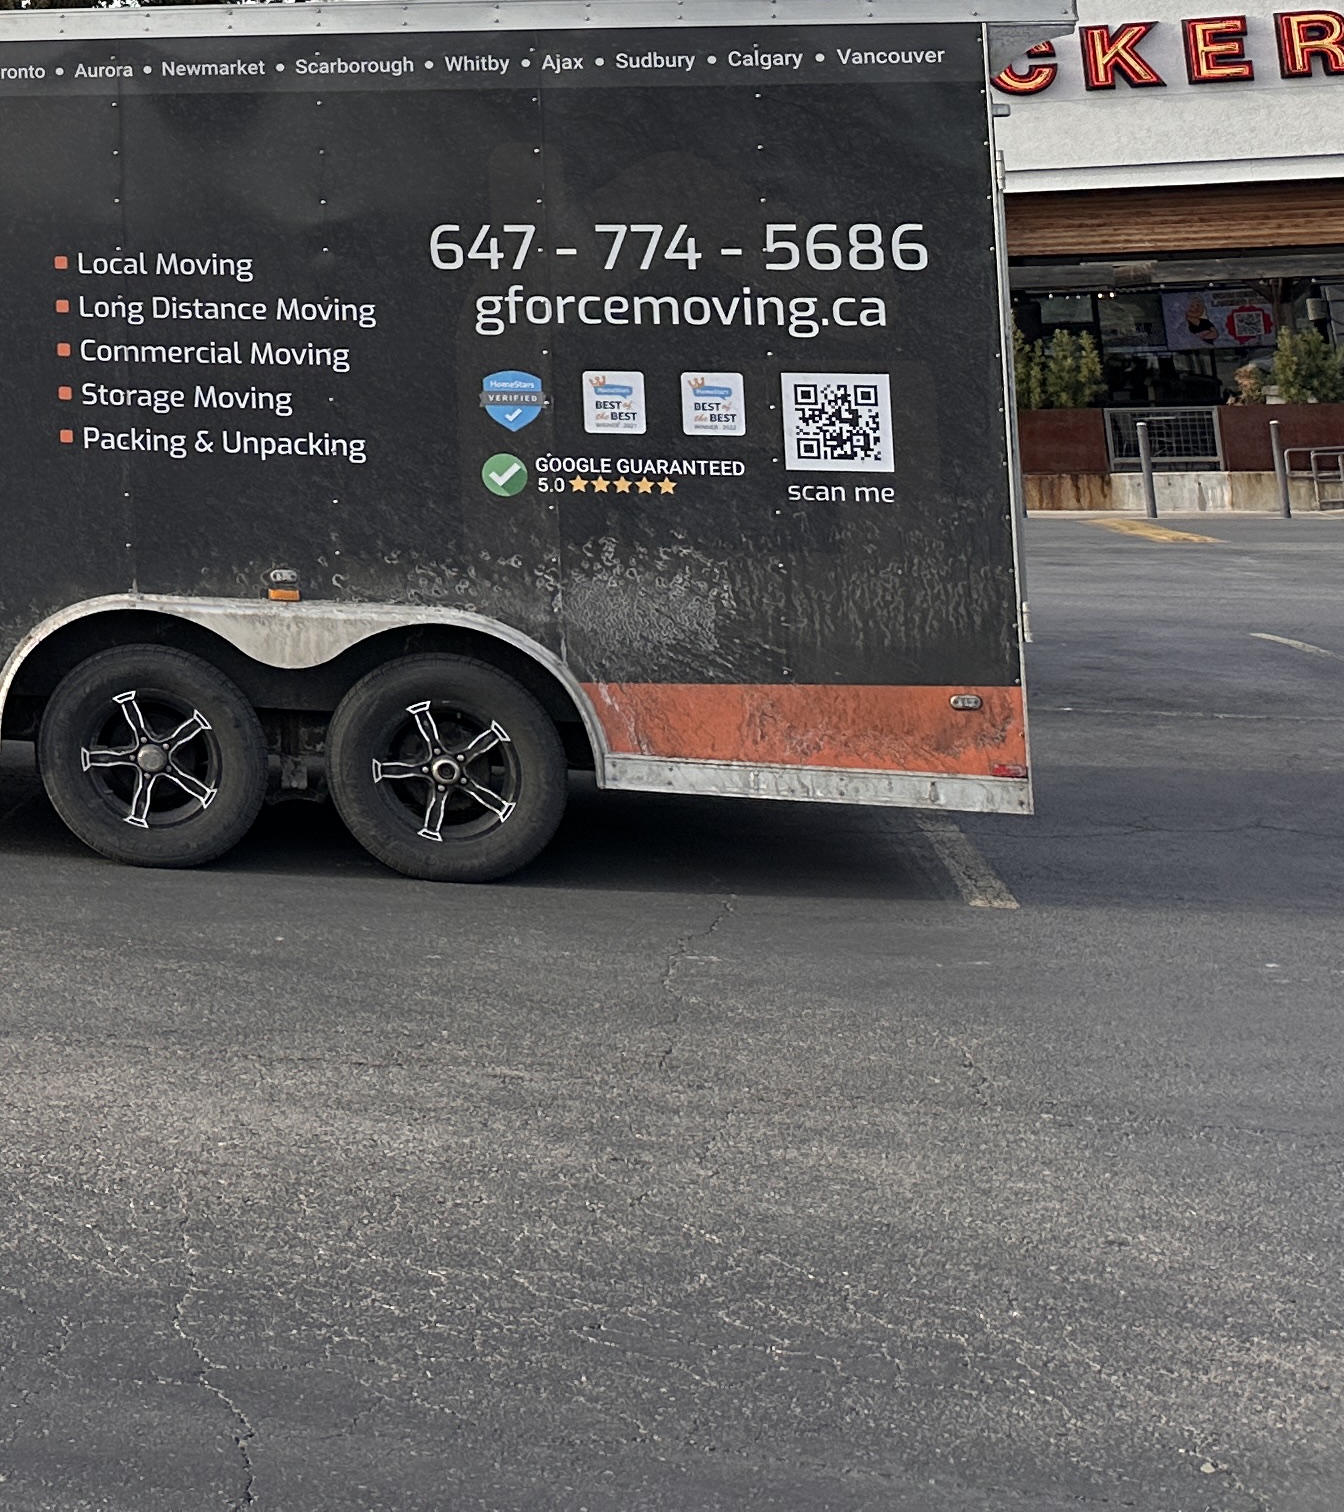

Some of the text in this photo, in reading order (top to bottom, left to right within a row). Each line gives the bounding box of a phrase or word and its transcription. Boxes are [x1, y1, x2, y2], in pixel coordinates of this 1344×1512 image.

[74, 63, 134, 79] Aurora
[161, 59, 266, 77] Newmarket
[295, 56, 414, 77] Scarborough
[444, 55, 510, 75] Whitby
[541, 54, 584, 74] Ajax
[615, 51, 696, 72] Sudbury
[727, 49, 804, 71] Calgary
[836, 48, 946, 66] Vancouver
[429, 224, 536, 270] 647
[594, 224, 703, 270] 774
[763, 223, 928, 271] 5686
[77, 253, 254, 283] Local Moving
[79, 296, 377, 328] Long Distance Moving
[475, 285, 887, 338] gforcemoving.ca
[80, 338, 351, 373] Commercial Moving
[489, 380, 535, 389] HomeStars
[81, 382, 293, 417] Storage Moving
[488, 394, 538, 402] VERIFIED
[595, 400, 622, 410] BEST
[694, 402, 721, 411] BEST
[610, 412, 638, 421] BEST
[709, 414, 737, 423] BEST
[83, 426, 367, 464] Packing & Unpacking
[535, 457, 746, 477] GOOGLE GUARANTEED
[537, 477, 566, 493] 5.0
[787, 483, 895, 503] scan me
